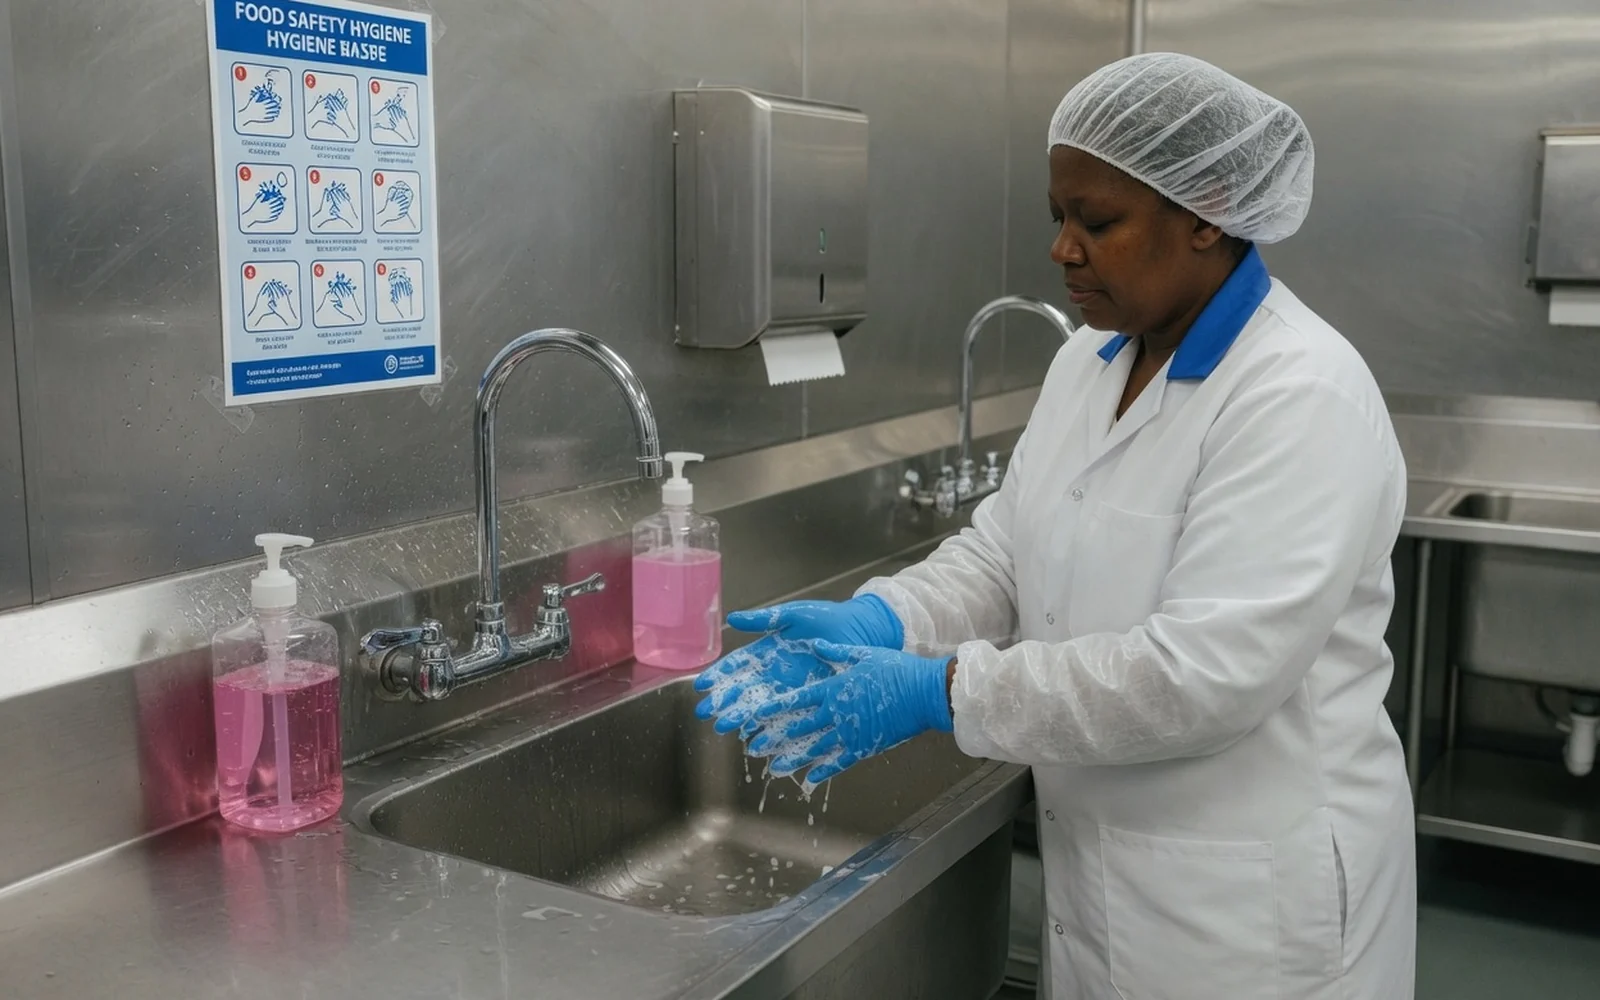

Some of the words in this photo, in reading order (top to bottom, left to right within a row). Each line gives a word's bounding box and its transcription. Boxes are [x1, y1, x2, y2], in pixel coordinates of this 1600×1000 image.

[235, 1, 284, 25] FOOD
[288, 10, 347, 34] SAFETY
[350, 20, 412, 45] HYGIENE
[267, 30, 336, 56] HYGIENE
